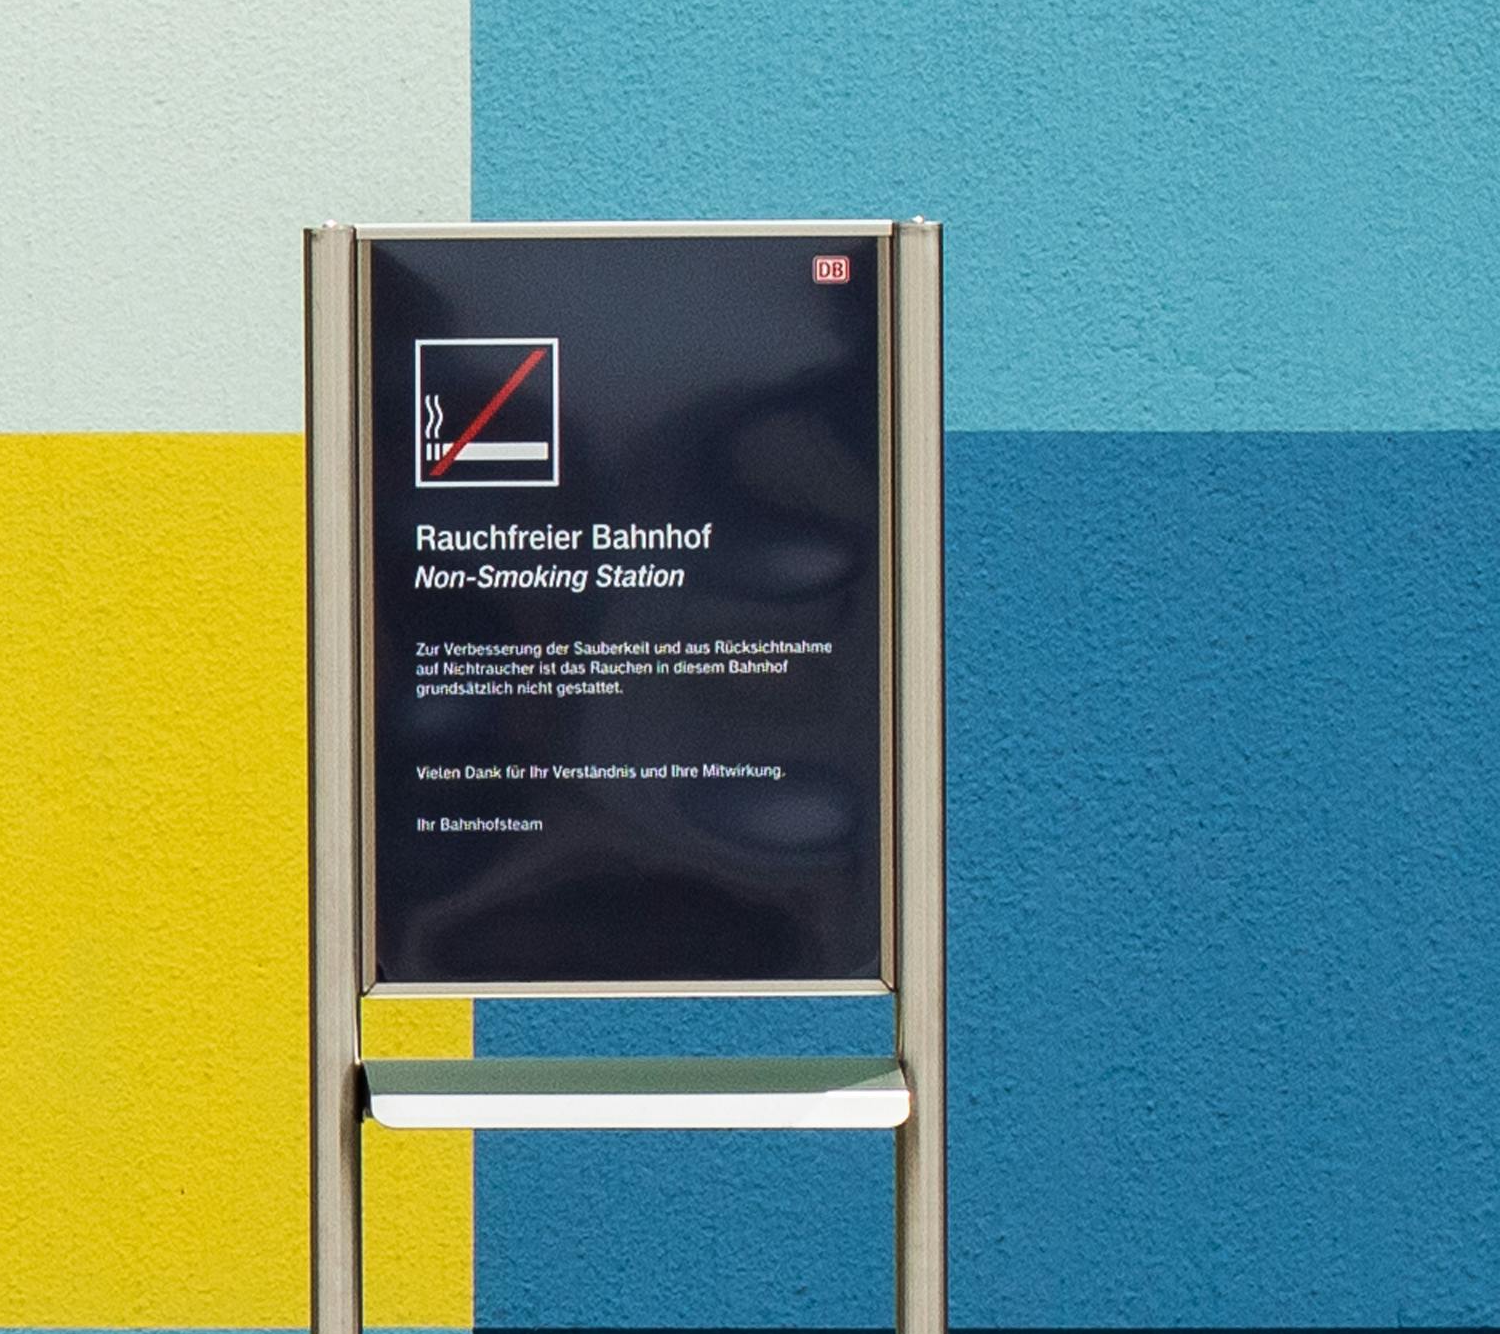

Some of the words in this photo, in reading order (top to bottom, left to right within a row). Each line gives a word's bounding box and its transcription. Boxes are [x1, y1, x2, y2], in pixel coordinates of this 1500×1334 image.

[819, 262, 844, 278] DB
[416, 524, 583, 551] Rauchfreier
[592, 522, 713, 550] Bahnhof
[414, 565, 589, 593] Non-Smoking
[595, 564, 685, 588] Station
[416, 642, 440, 656] Zur
[443, 642, 542, 658] Verbesserung
[546, 642, 569, 656] der
[574, 641, 650, 655] Sauberkeit
[654, 641, 681, 655] und
[685, 643, 711, 655] aus
[715, 640, 833, 654] Rücksichtnahme
[416, 662, 439, 676] auf
[443, 662, 535, 676] Nichtraucher
[539, 661, 556, 675] ist
[560, 661, 586, 675] das
[590, 661, 653, 675] Rauchen
[656, 661, 670, 674] in
[674, 660, 725, 674] diesem
[729, 659, 789, 674] Bahnhof
[416, 681, 513, 698] grundsätzlich
[517, 681, 553, 695] nicht
[556, 681, 624, 698] gestattet.
[416, 765, 461, 780] Vielen
[465, 765, 502, 779] Dank
[506, 765, 526, 779] für
[530, 765, 549, 779] Ihr
[553, 765, 636, 779] Verständnis
[640, 765, 667, 779] und
[671, 764, 699, 779] Ihre
[703, 764, 786, 781] Mitwirkung.
[417, 818, 436, 832] Ihr
[440, 817, 543, 832] Bahnhofsteam
